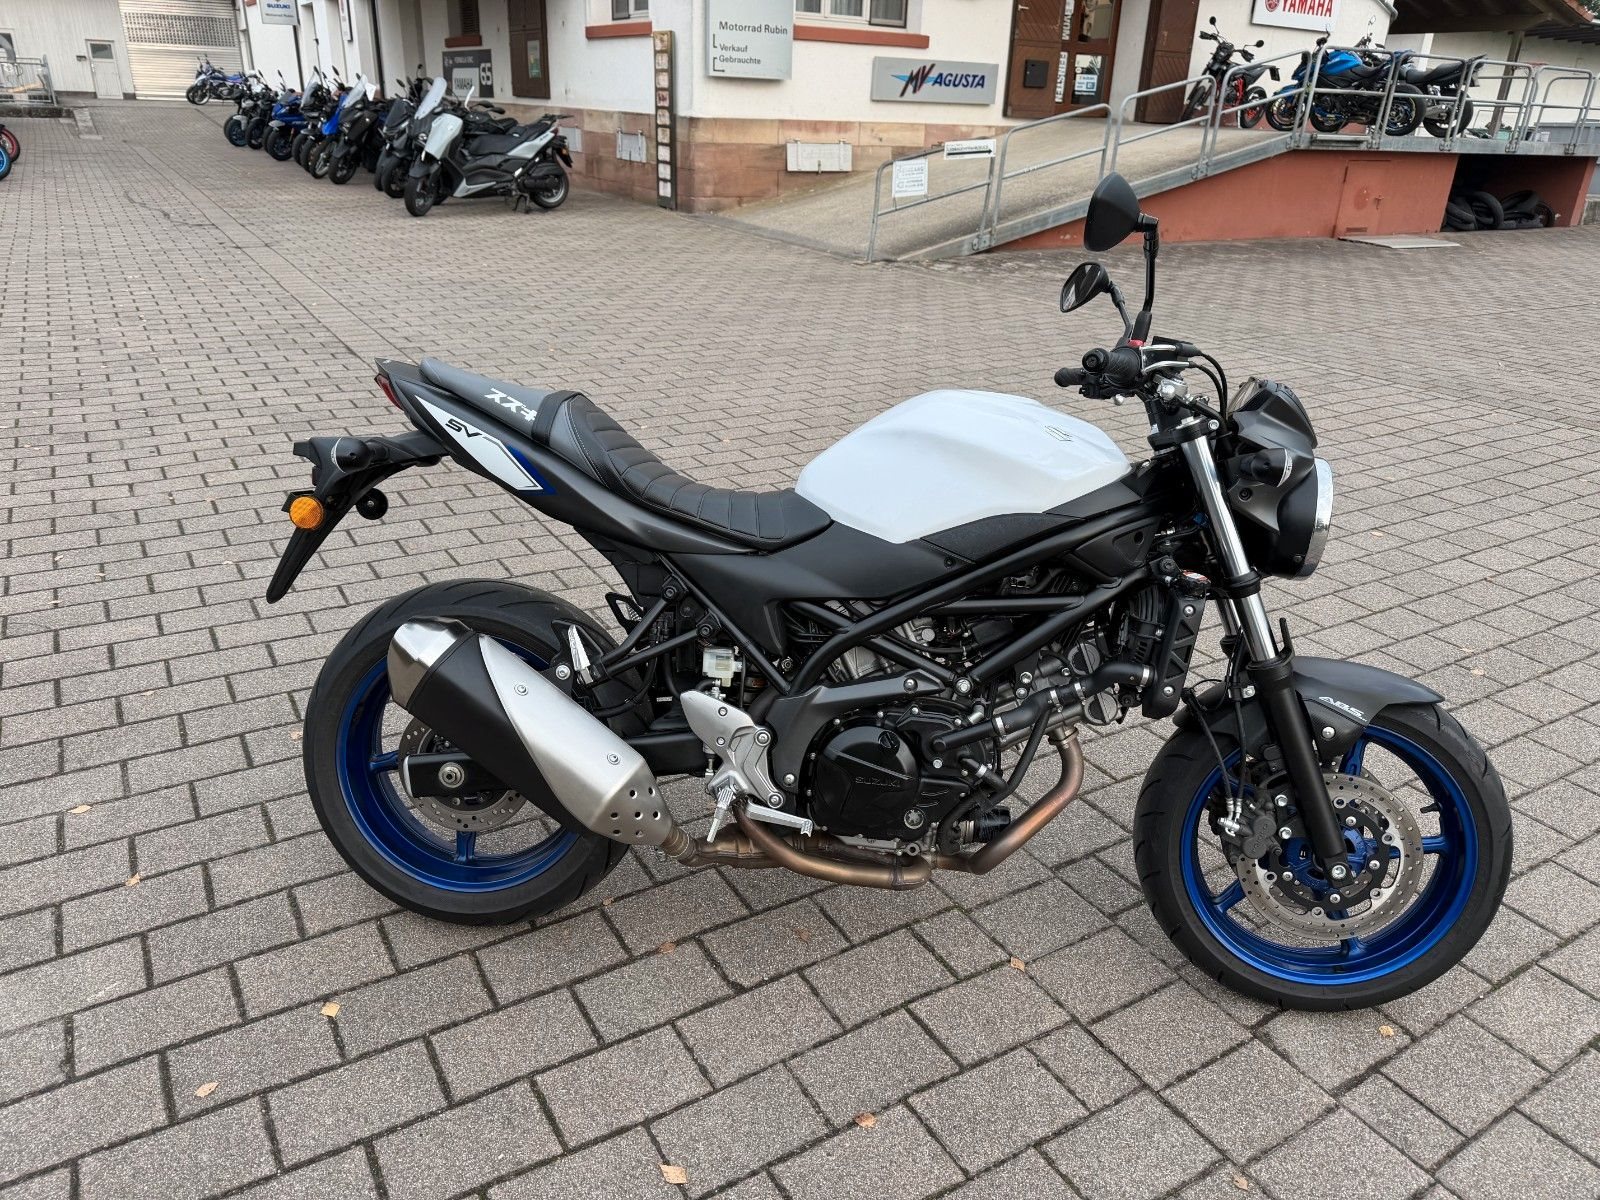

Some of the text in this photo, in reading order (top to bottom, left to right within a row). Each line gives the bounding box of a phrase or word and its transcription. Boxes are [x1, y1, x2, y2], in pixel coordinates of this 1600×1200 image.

[1282, 0, 1332, 17] YAMAHA
[719, 21, 788, 35] Motorrad Rubin
[719, 43, 748, 53] Verkauf
[718, 54, 761, 65] Gebrauchte
[480, 62, 492, 86] 65
[899, 63, 985, 97] MV AGUSTA
[445, 418, 483, 438] SV
